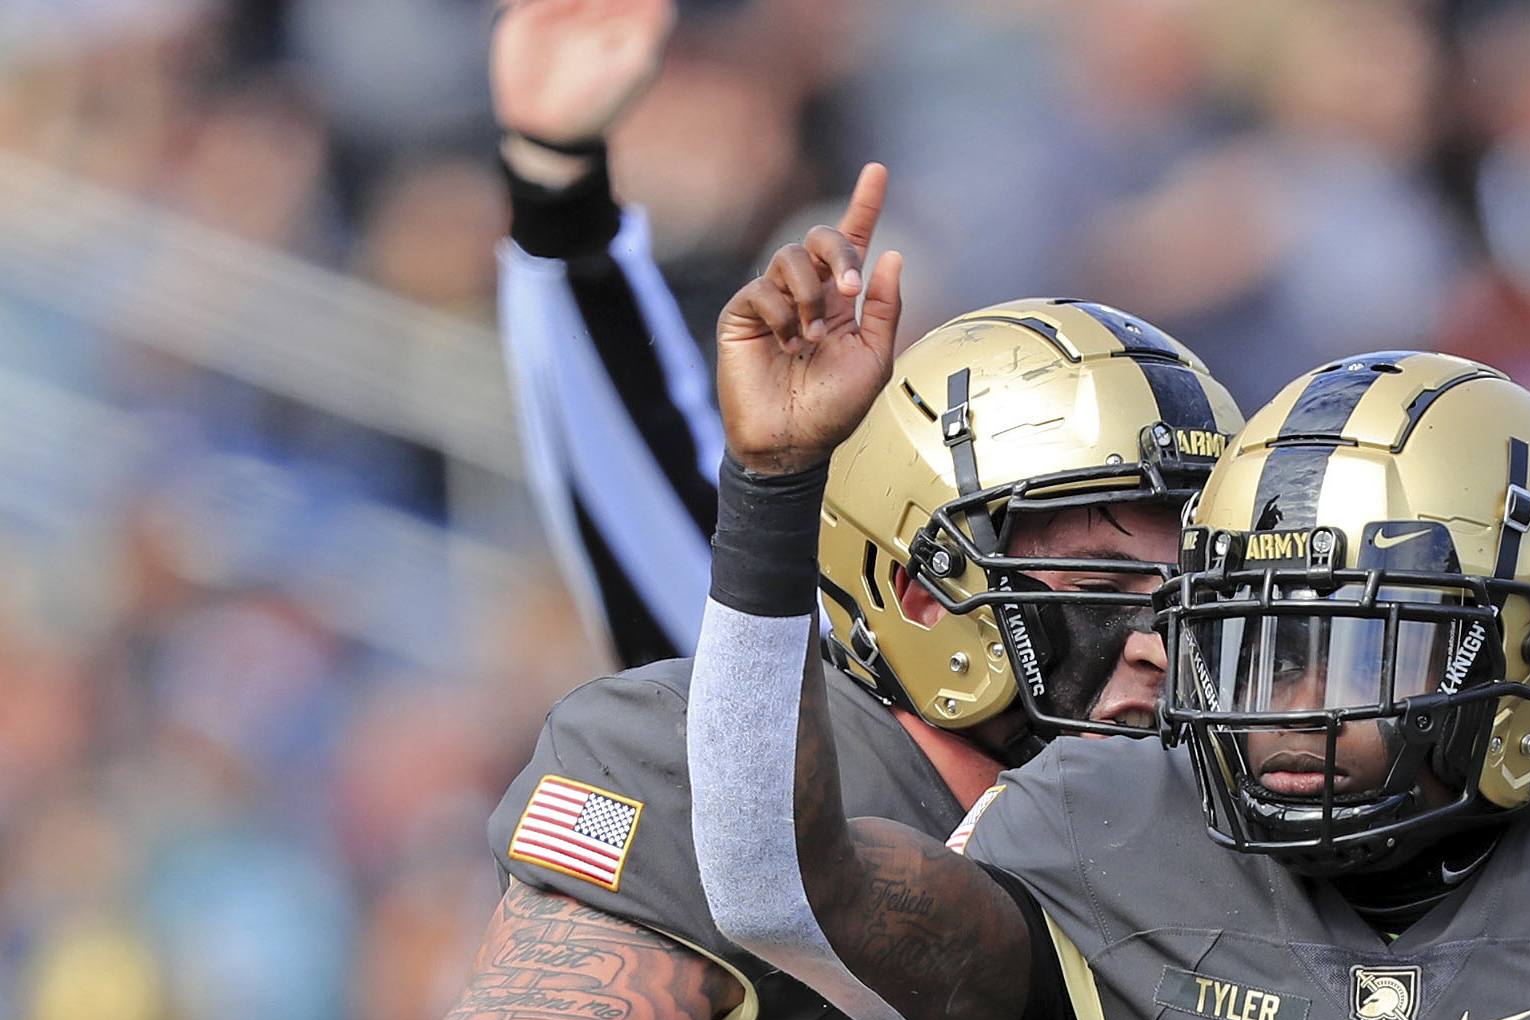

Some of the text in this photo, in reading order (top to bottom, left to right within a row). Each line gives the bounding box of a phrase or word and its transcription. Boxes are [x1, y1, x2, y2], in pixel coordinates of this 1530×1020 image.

[1176, 429, 1226, 458] ARM
[1245, 532, 1309, 560] ARMY
[1008, 614, 1046, 697] KNIGHTS
